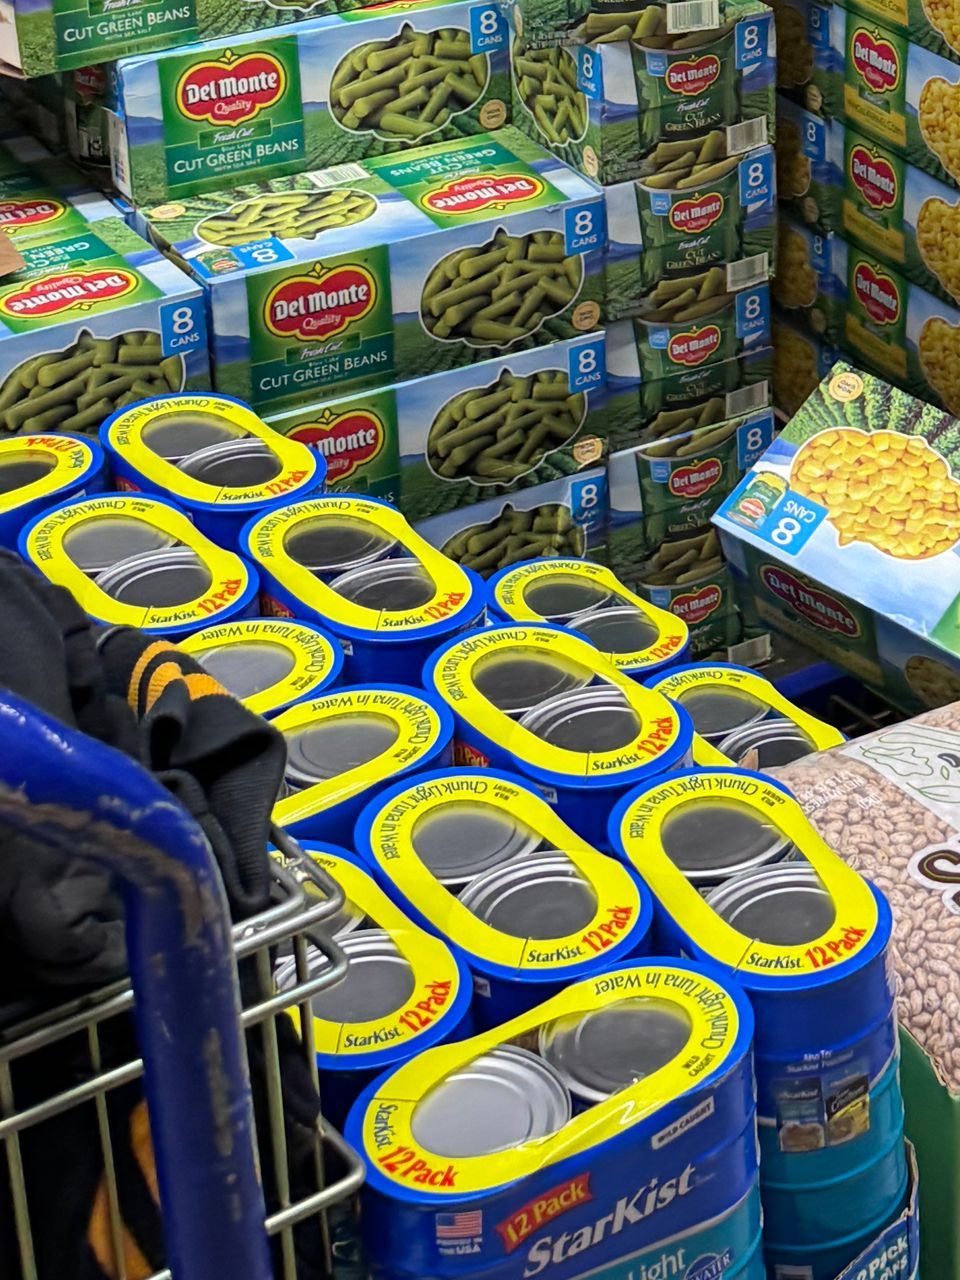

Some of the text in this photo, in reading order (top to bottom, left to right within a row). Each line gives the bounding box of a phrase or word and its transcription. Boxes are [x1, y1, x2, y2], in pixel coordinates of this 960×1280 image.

[63, 6, 191, 43] CUT GREEN BEANS
[479, 10, 498, 35] 8
[477, 35, 503, 47] CANS
[743, 24, 759, 50] 8
[582, 53, 594, 79] 8
[185, 69, 279, 105] Del Monte
[213, 99, 252, 116] Quality
[173, 138, 299, 174] CUT GREEN BEANS
[747, 162, 765, 188] 8
[574, 210, 593, 236] 8
[571, 235, 598, 249] CANS
[251, 248, 276, 264] 8
[11, 282, 94, 312] Monte
[273, 283, 369, 321] Del Monte
[744, 294, 761, 320] 8
[172, 306, 195, 333] 8
[302, 313, 342, 331] Quality
[169, 331, 201, 348] CANS
[259, 350, 388, 392] CUT GREEN BEANS
[578, 348, 597, 373] 8
[574, 372, 602, 387] CANS
[317, 427, 376, 454] Monte
[745, 427, 764, 451] 8
[580, 483, 598, 508] 8
[783, 500, 817, 524] CANS
[770, 516, 802, 546] 8
[147, 578, 242, 624] StarKist 12 Pack
[381, 605, 447, 628] StarKist 12
[200, 627, 244, 642] Water
[311, 696, 355, 712] Water
[591, 715, 674, 771] StarKist 12 Pack
[444, 779, 489, 795] Chunk
[714, 777, 760, 798] Chunk
[526, 904, 634, 965] StarKist 12 Pack
[745, 925, 868, 970] StarKist 12 Pack
[593, 974, 643, 997] Water
[343, 979, 453, 1049] StarKist 12 Pack
[700, 1012, 729, 1051] Chunk
[677, 1102, 713, 1132] CAUGHT
[372, 1102, 457, 1188] StarKist 12 Pack
[505, 1181, 589, 1242] 12 Pack
[522, 1161, 698, 1280] StarKist
